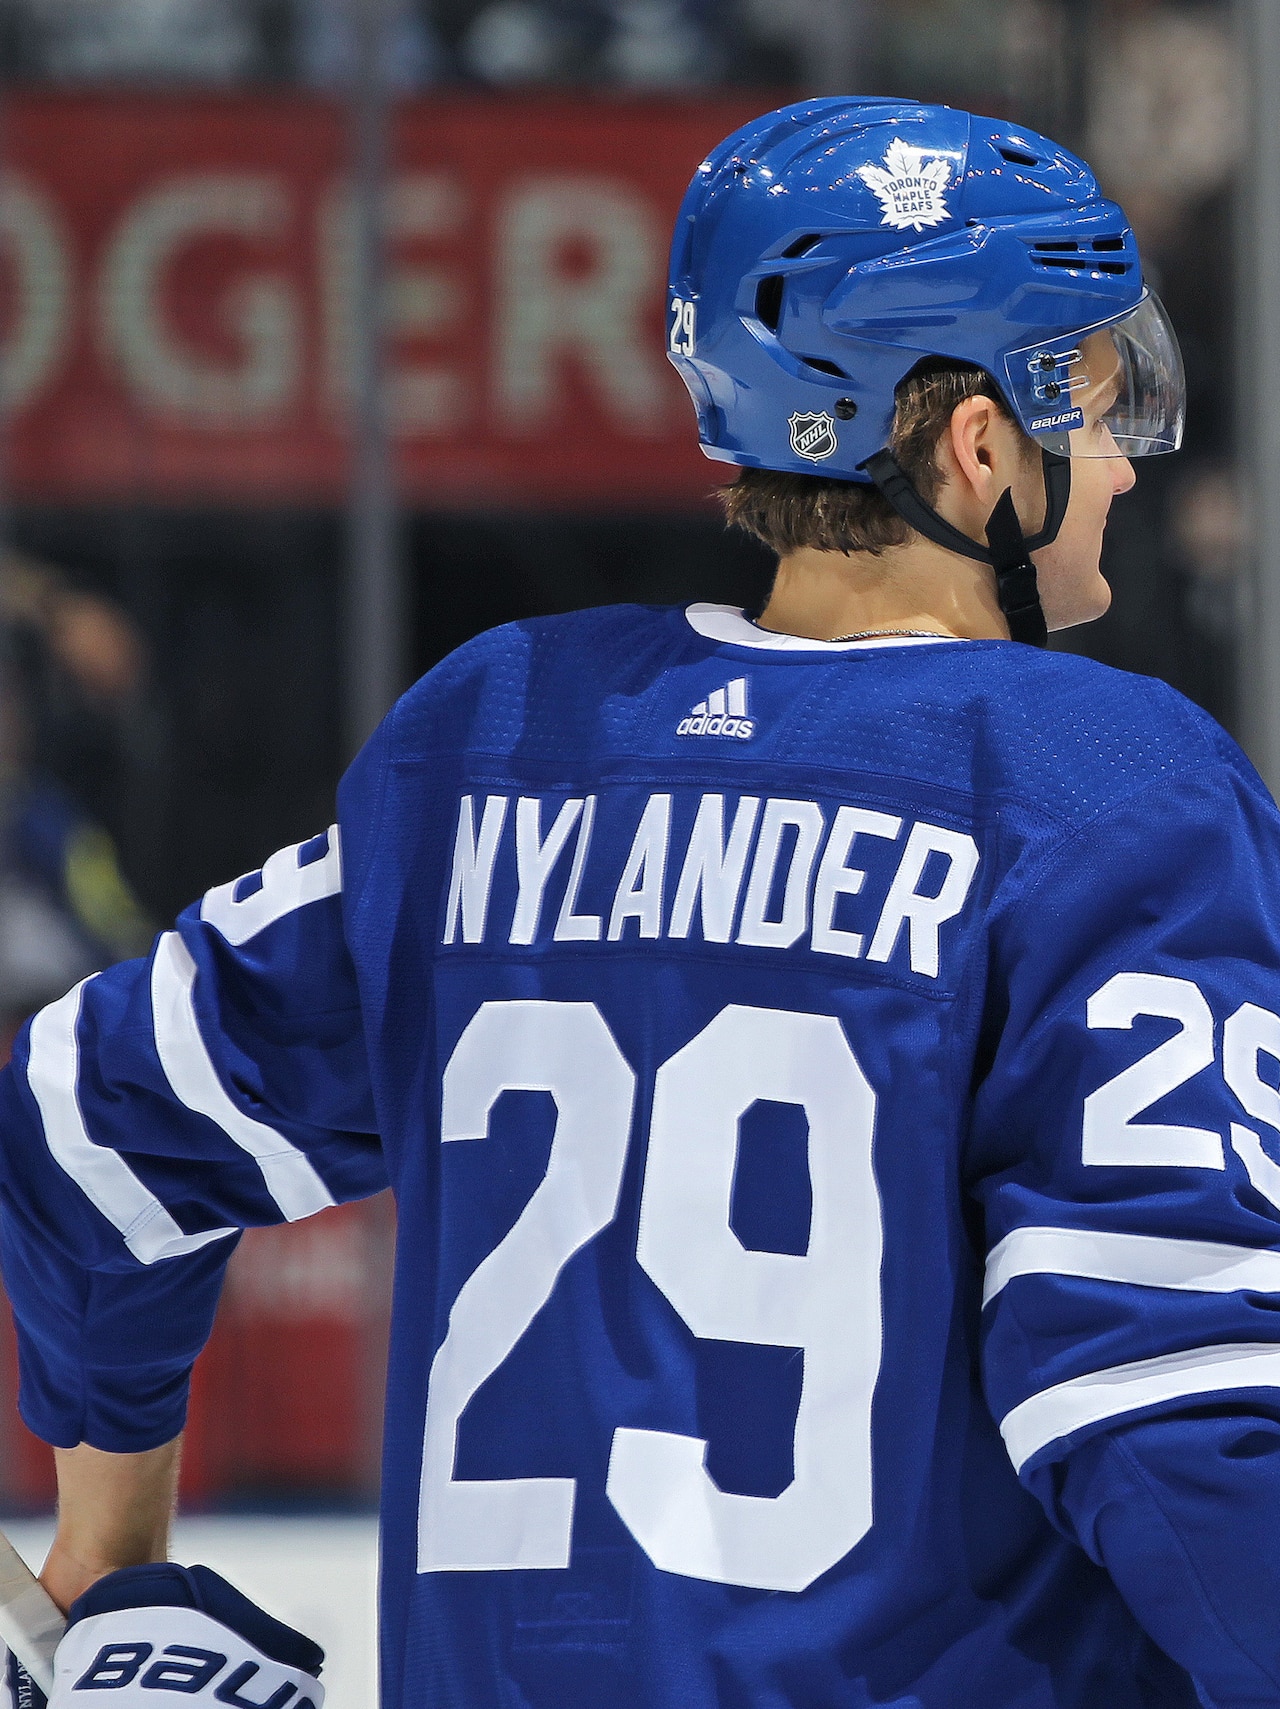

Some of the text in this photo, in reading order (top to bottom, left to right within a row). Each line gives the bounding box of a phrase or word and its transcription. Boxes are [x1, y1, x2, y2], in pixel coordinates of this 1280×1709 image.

[881, 177, 938, 196] TORONTO
[892, 190, 932, 203] MAPLE
[895, 201, 934, 214] LEAFS
[670, 298, 695, 357] 29
[800, 423, 827, 450] NHL
[676, 712, 754, 739] adidas
[441, 793, 981, 979] NYLANDER
[417, 1000, 884, 1593] 29
